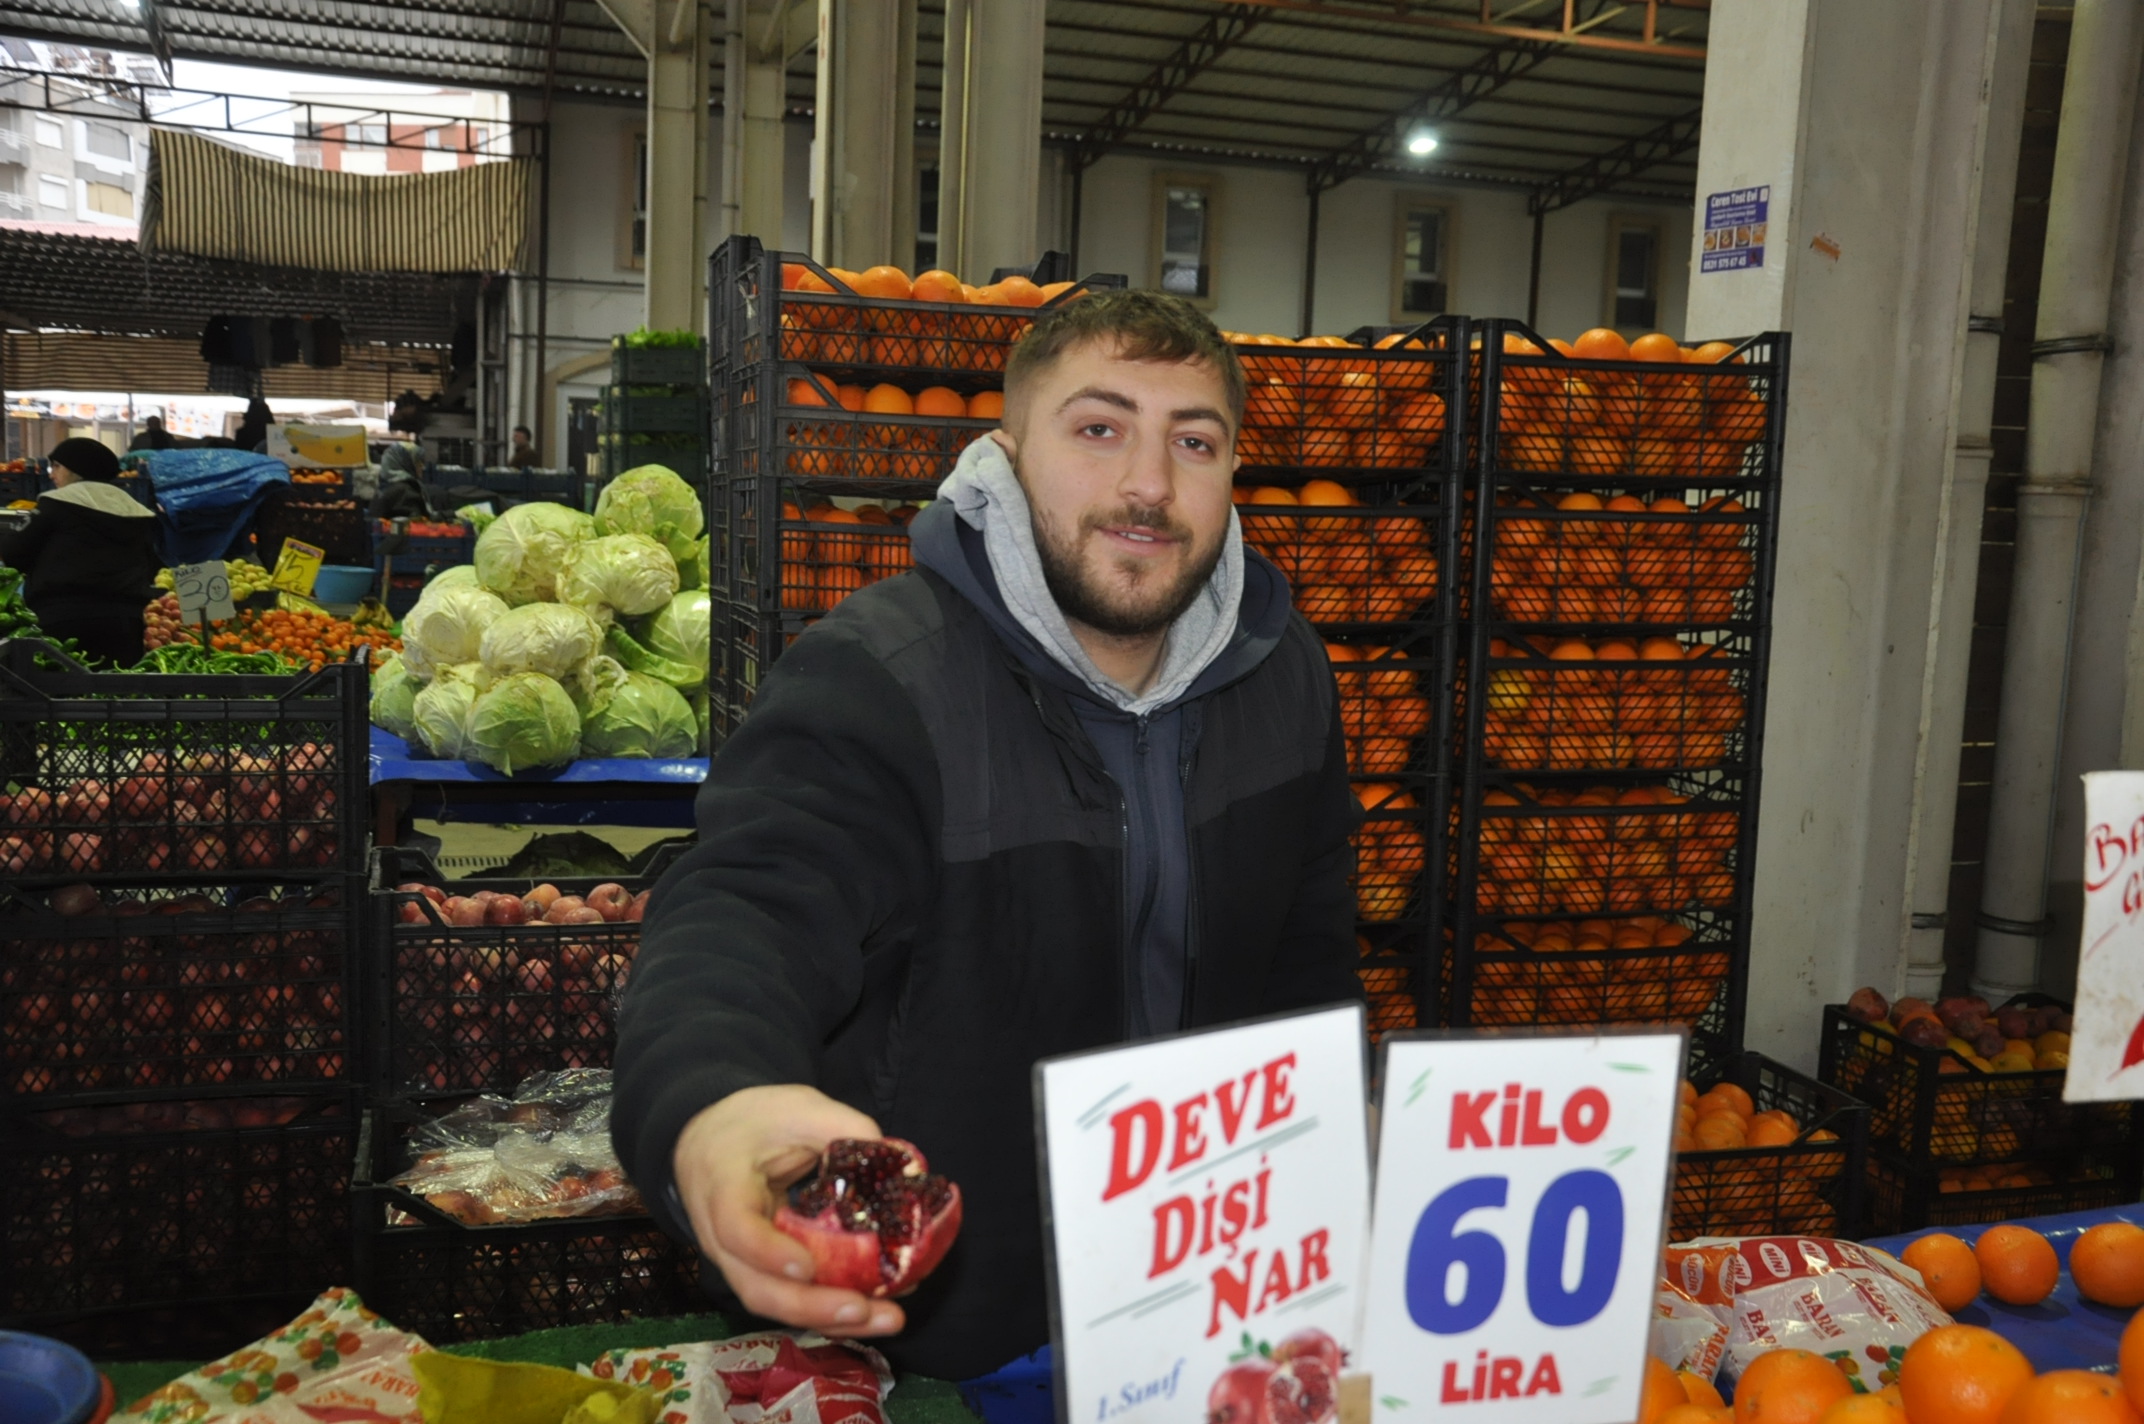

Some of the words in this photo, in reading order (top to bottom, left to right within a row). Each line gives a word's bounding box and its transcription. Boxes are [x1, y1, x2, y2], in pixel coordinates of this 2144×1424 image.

[1101, 1051, 1297, 1202] DEVE
[1147, 1151, 1273, 1280] DİŞİ
[1404, 1167, 1626, 1336] 60
[1205, 1227, 1332, 1340] NAR
[1801, 1291, 1846, 1338] BARAN
